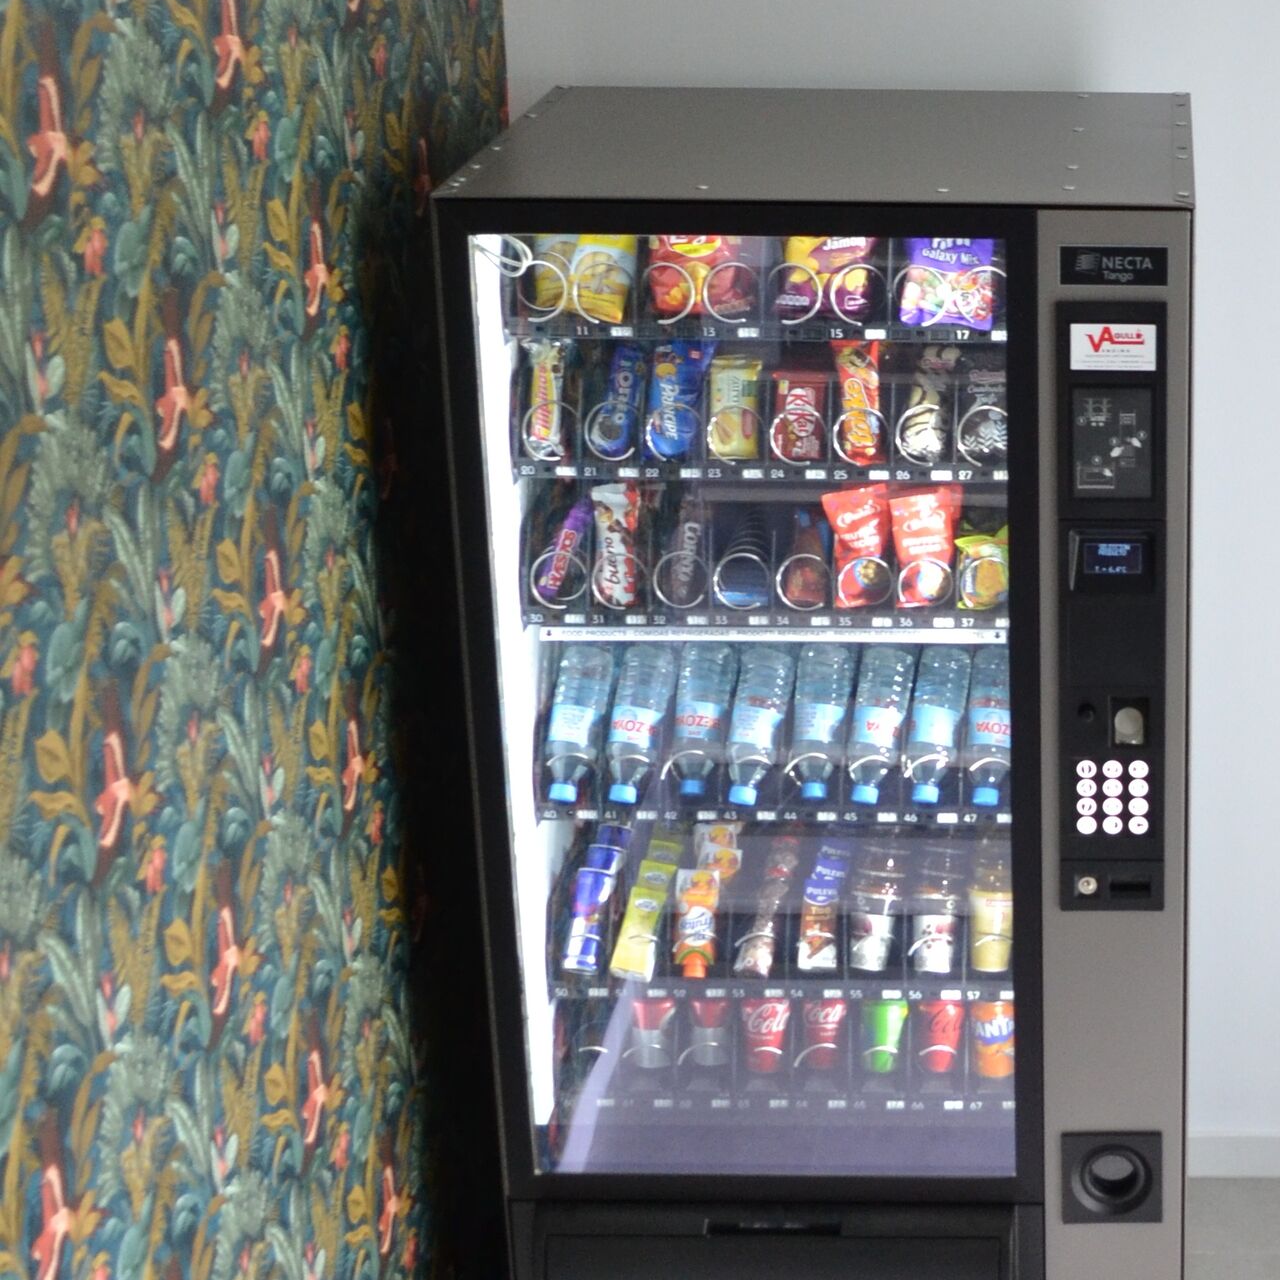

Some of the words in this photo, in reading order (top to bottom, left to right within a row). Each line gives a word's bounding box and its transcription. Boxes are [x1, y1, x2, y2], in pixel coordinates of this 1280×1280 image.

[921, 248, 958, 265] Galaxy
[1102, 256, 1153, 270] NECTA
[1103, 271, 1134, 283] Tango
[576, 325, 589, 336] 11
[703, 326, 716, 337] 13
[830, 328, 844, 339] 15
[955, 329, 970, 340] 17
[520, 465, 535, 475] 20
[583, 466, 597, 477] 21
[645, 467, 660, 478] 22
[707, 468, 722, 479] 23
[770, 468, 785, 479] 24
[833, 469, 849, 480] 25
[895, 470, 911, 481] 26
[958, 469, 973, 481] 27
[604, 536, 621, 586] bueno
[529, 613, 544, 623] 30
[592, 614, 604, 625] 31
[653, 615, 666, 625] 32
[714, 615, 729, 625] 33
[776, 616, 790, 626] 34
[838, 616, 853, 627] 35
[899, 617, 914, 627] 36
[961, 617, 975, 628] 37
[542, 810, 557, 819] 40
[604, 810, 617, 819] 41
[663, 810, 677, 820] 42
[723, 810, 738, 821] 43
[783, 811, 798, 820] 44
[843, 812, 858, 822] 45
[903, 813, 918, 823] 46
[963, 813, 977, 823] 47
